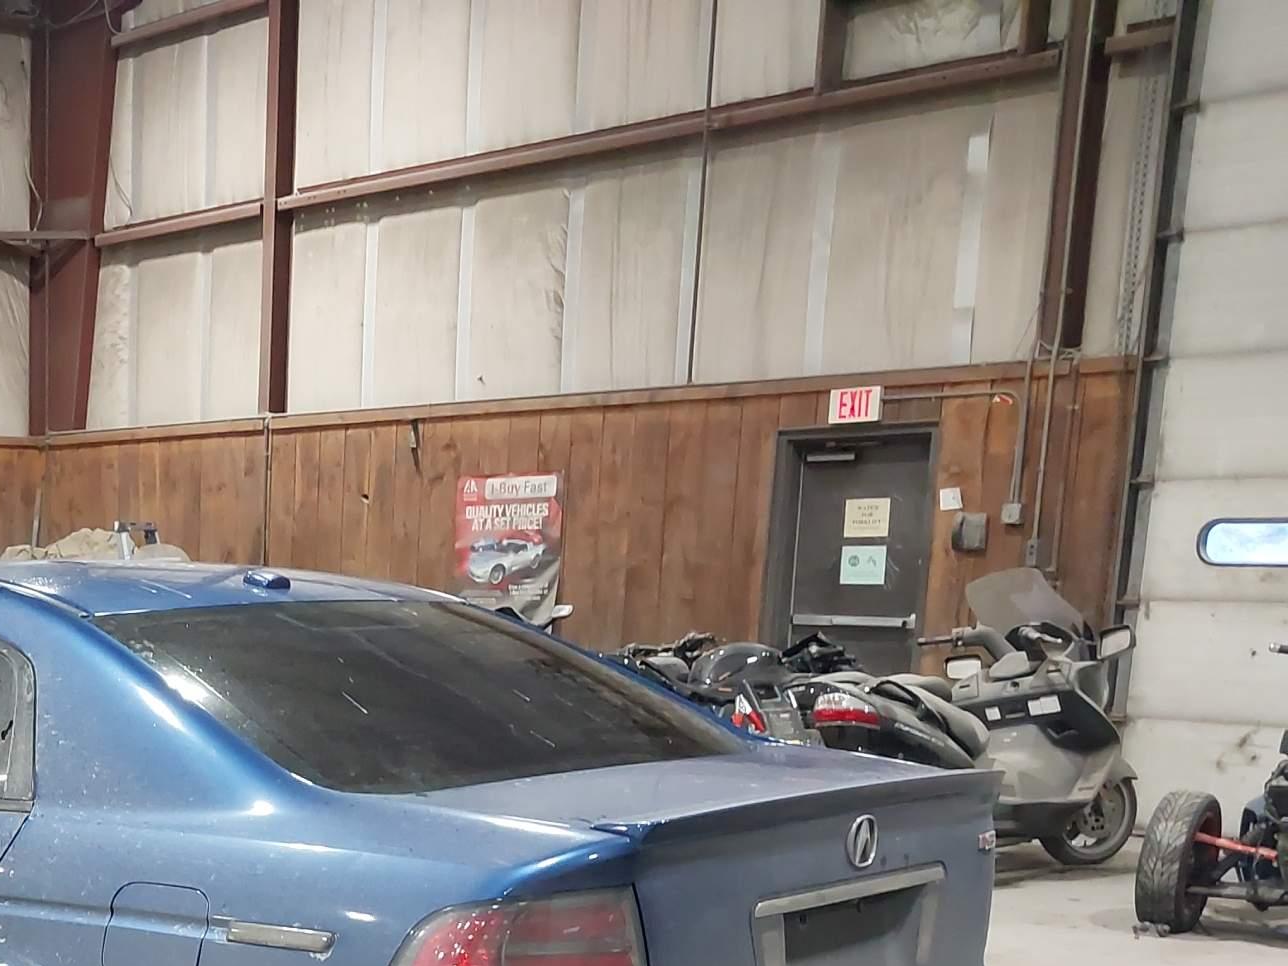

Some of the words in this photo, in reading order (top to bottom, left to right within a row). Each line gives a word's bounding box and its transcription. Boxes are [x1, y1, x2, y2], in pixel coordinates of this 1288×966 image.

[838, 389, 872, 418] EXIT
[524, 481, 547, 492] Fast
[465, 505, 504, 519] QUALITY
[505, 503, 549, 517] VEHICLES
[472, 519, 485, 531] AT
[494, 518, 511, 531] SET
